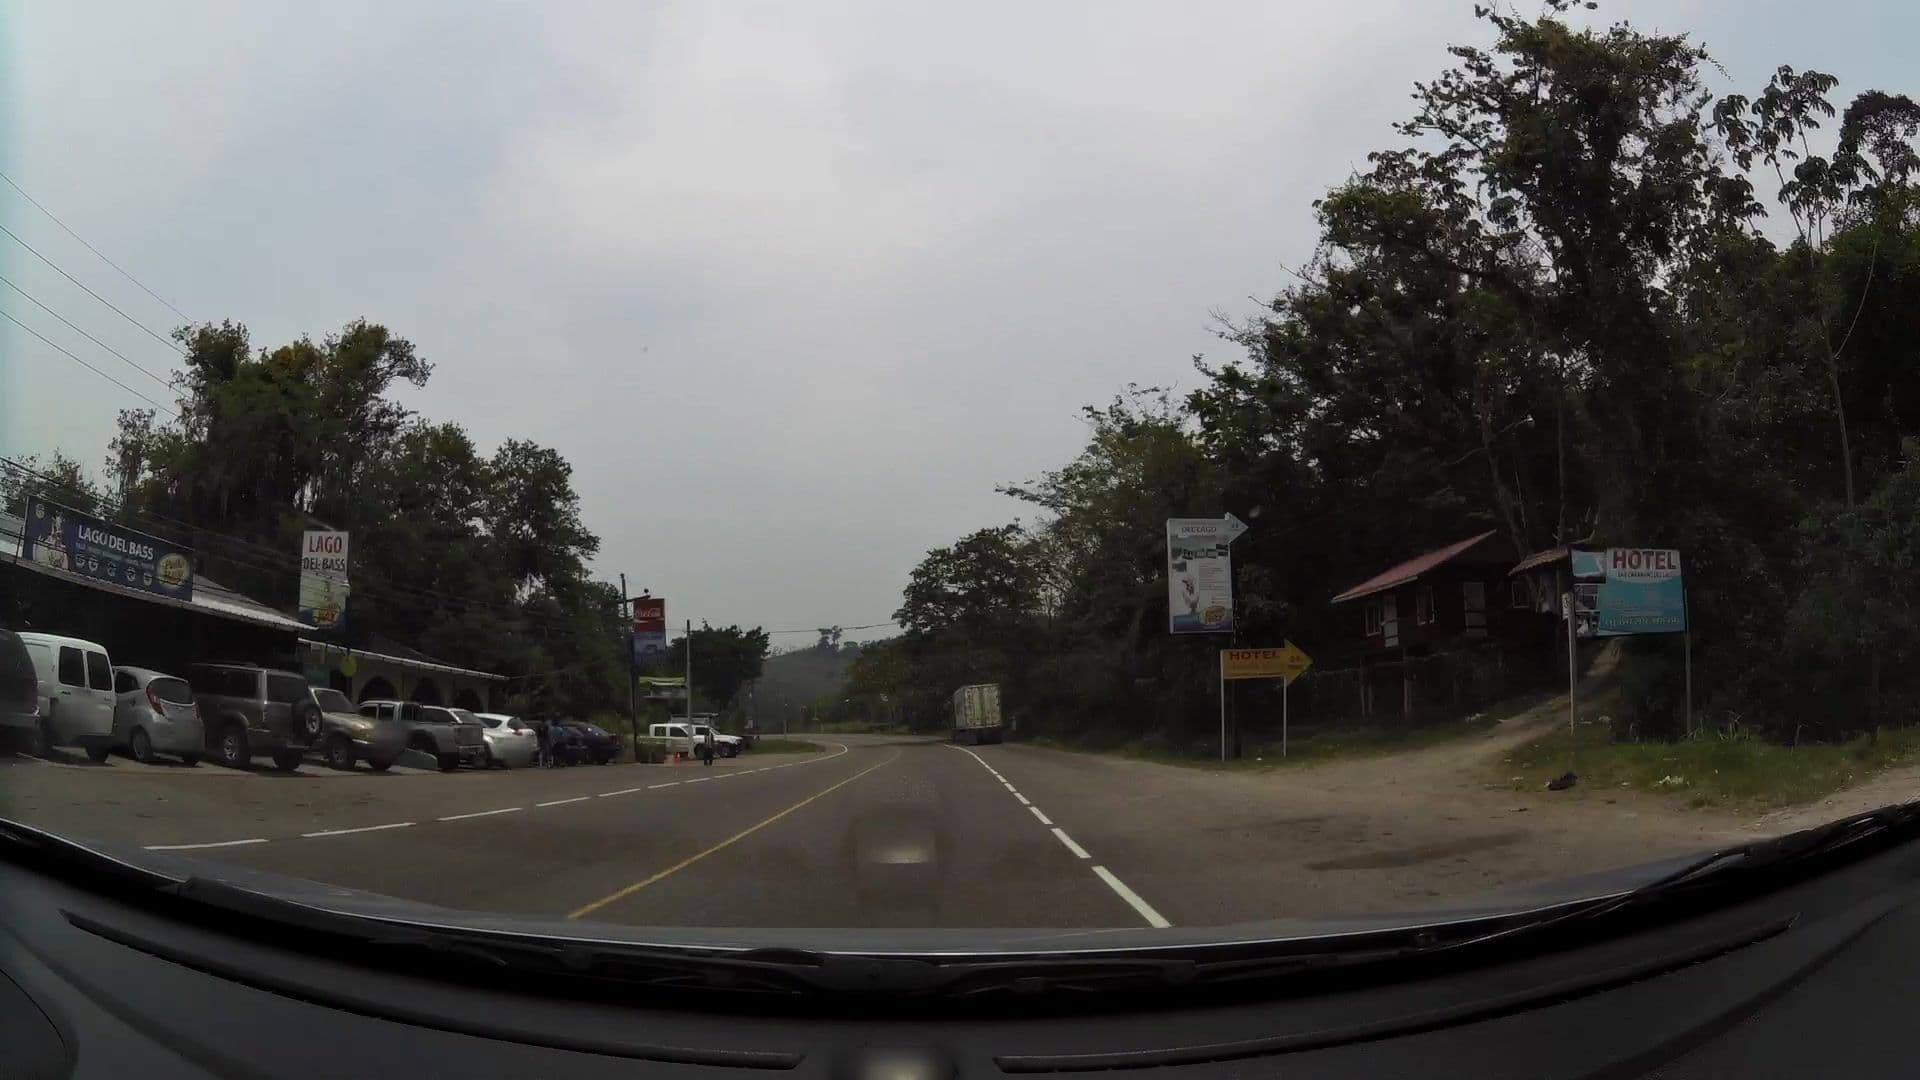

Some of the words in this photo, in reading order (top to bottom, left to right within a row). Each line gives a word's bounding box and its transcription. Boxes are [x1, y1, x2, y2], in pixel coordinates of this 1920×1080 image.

[78, 524, 107, 545] LAGO
[108, 534, 127, 553] DEL
[129, 541, 154, 560] BASS
[309, 535, 342, 553] LAGO
[303, 557, 320, 570] DEL
[322, 557, 345, 571] BASS
[1613, 550, 1677, 570] HOTEL
[1230, 650, 1279, 661] HOTEL
